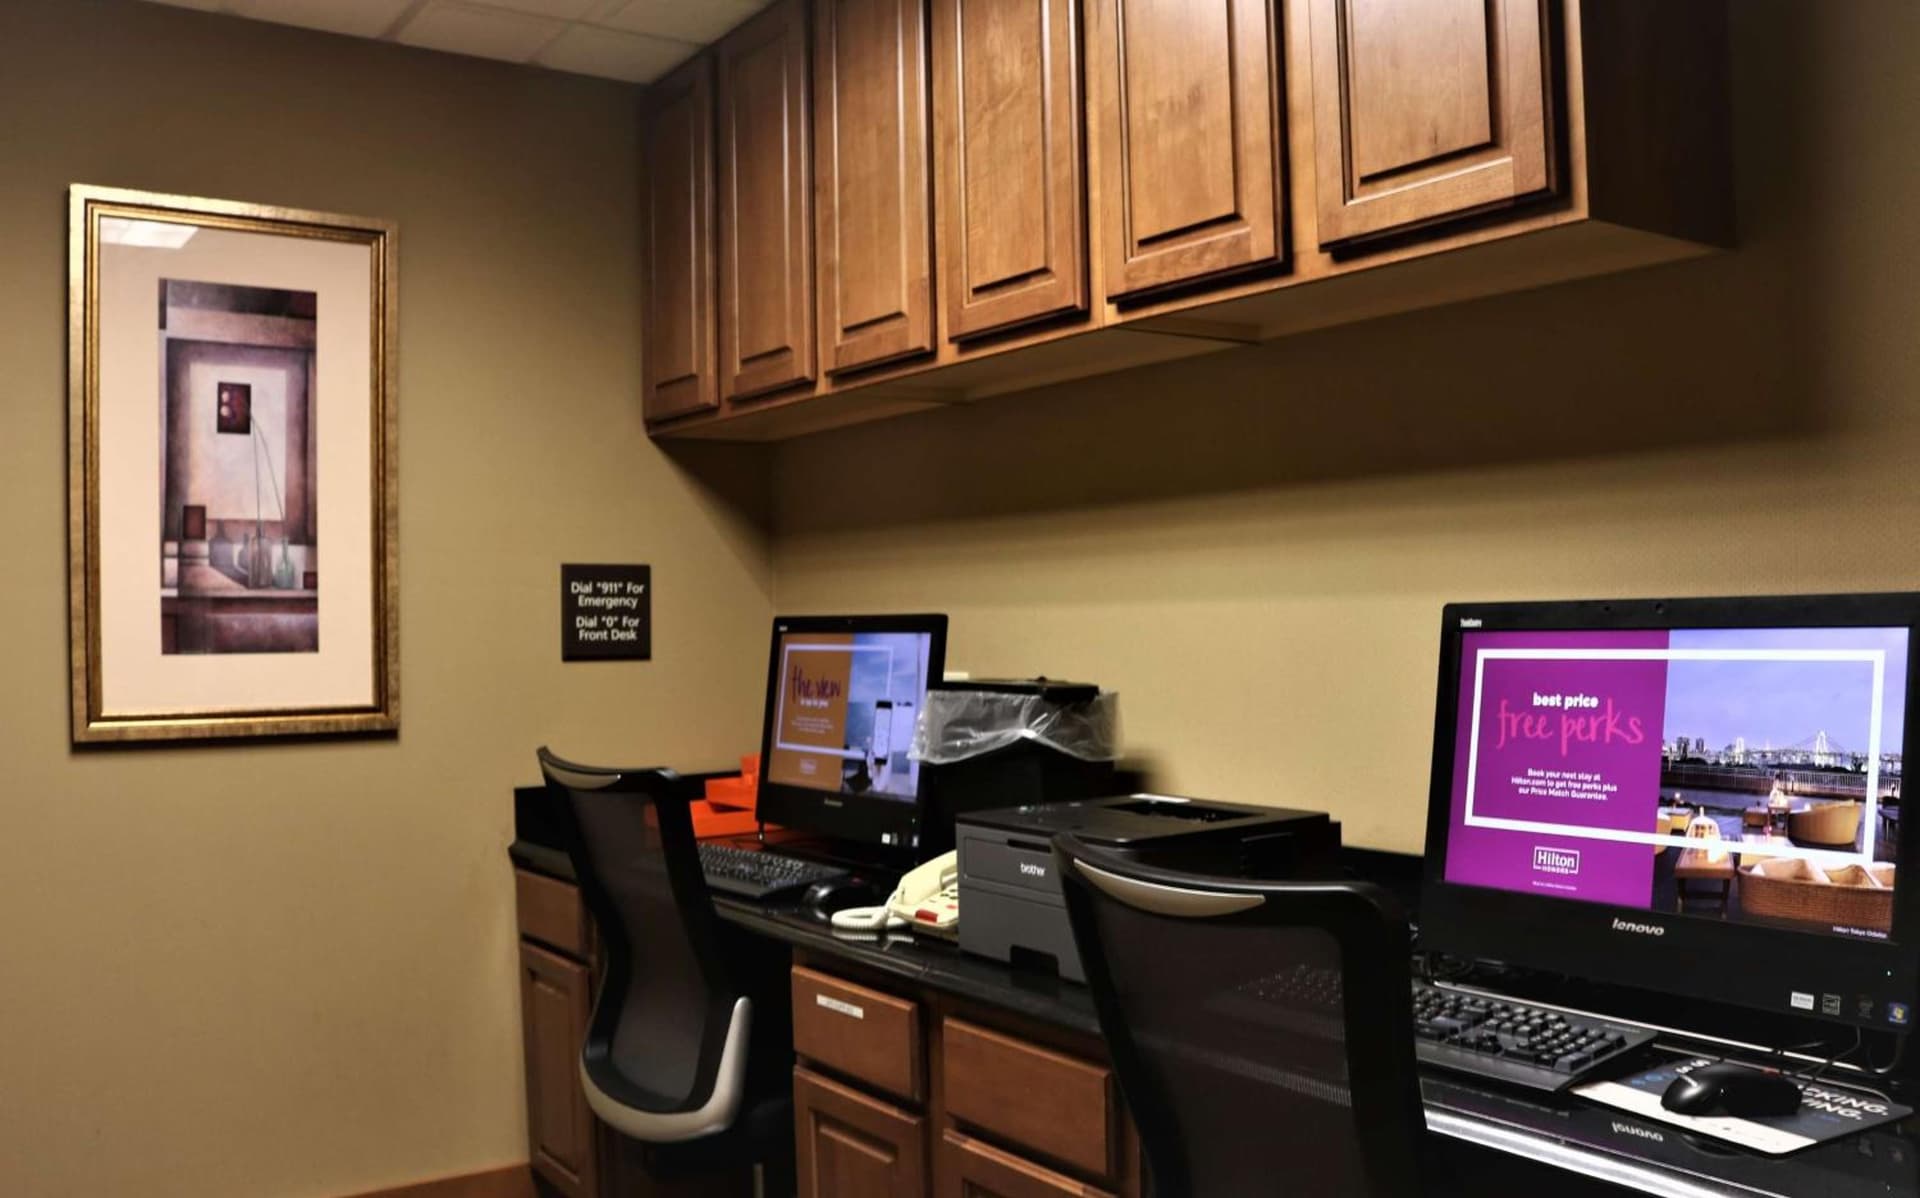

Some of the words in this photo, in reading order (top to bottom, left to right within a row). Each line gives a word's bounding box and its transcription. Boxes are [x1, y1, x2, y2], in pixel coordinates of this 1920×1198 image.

[570, 581, 593, 594] Dial
[596, 581, 624, 594] "911"
[626, 581, 645, 594] For
[577, 595, 639, 610] Emergency
[575, 616, 598, 629] Dial
[622, 616, 640, 628] For
[578, 629, 608, 641] Front
[610, 629, 637, 641] Desk
[791, 664, 812, 704] the
[1532, 692, 1562, 707] best
[1563, 693, 1600, 711] price
[1496, 698, 1553, 750] free
[1560, 697, 1644, 757] perks
[1527, 768, 1545, 777] Book
[1545, 769, 1561, 779] your
[1578, 772, 1592, 782] stay
[1511, 776, 1547, 787] Hilton.com
[1547, 780, 1555, 788] to
[1555, 780, 1567, 790] get
[1567, 781, 1581, 790] free
[1602, 784, 1618, 793] plus
[1518, 787, 1530, 795] our
[1530, 787, 1548, 796] Price
[1548, 789, 1570, 798] Match
[1537, 850, 1576, 869] Hilton
[1020, 861, 1046, 877] brother
[1612, 917, 1665, 936] lenovo
